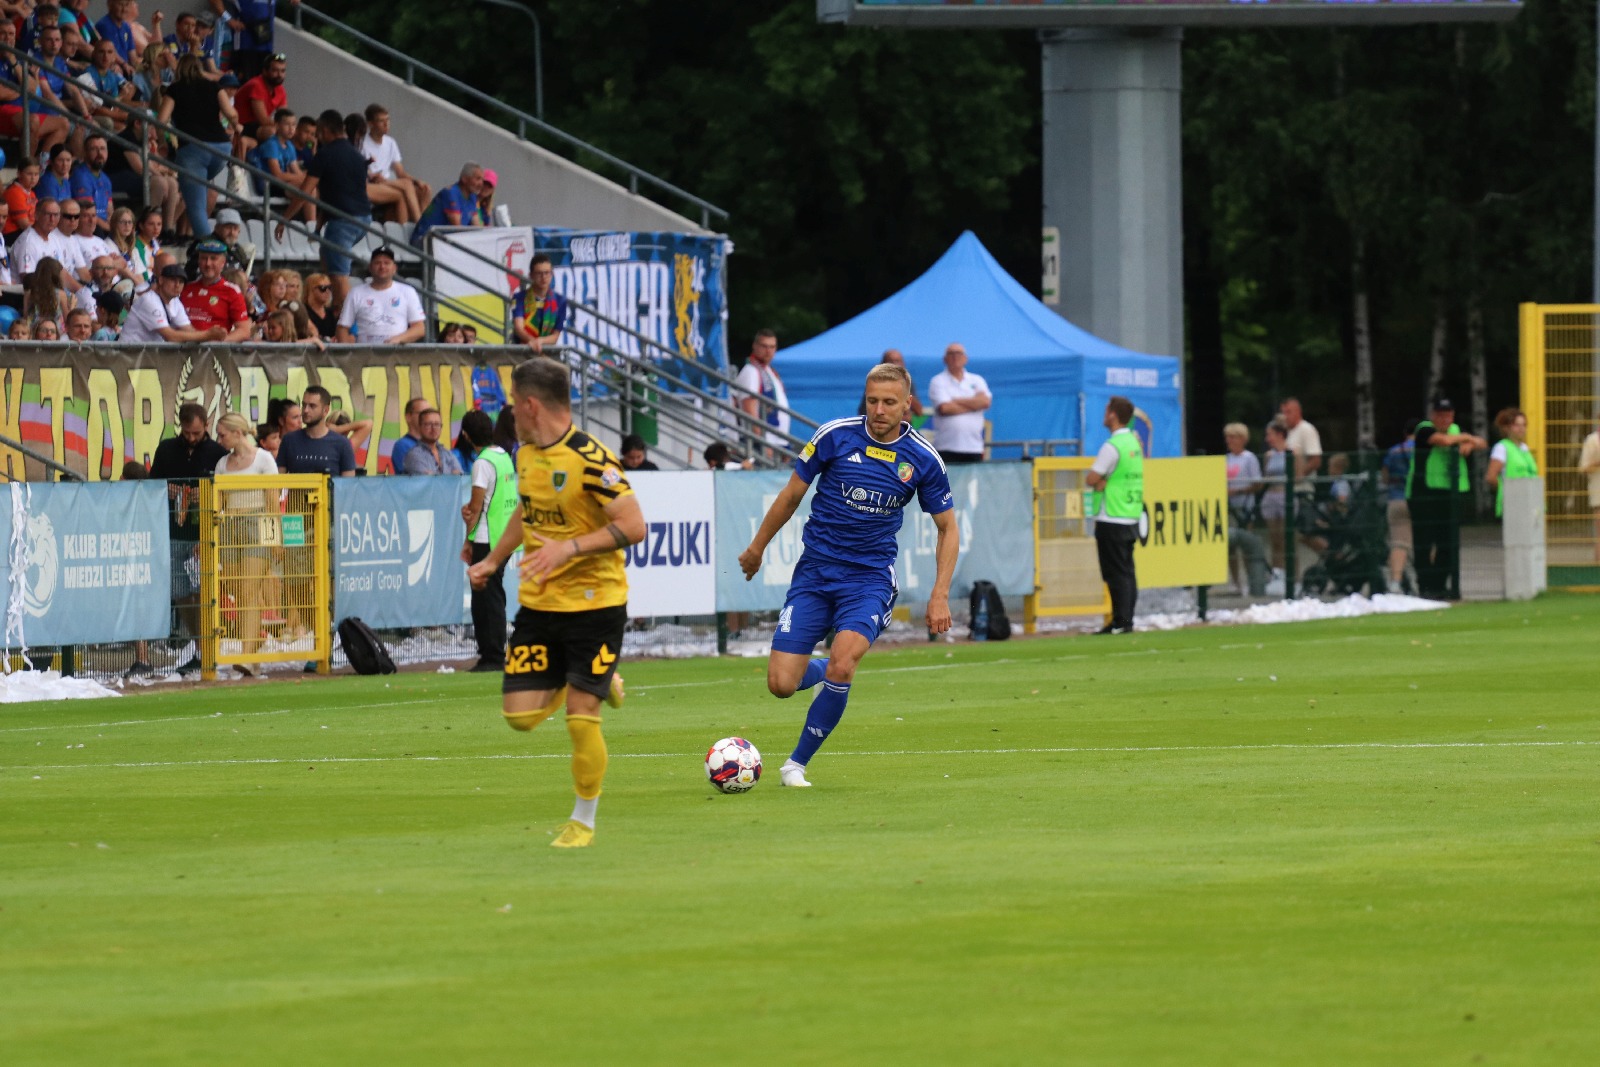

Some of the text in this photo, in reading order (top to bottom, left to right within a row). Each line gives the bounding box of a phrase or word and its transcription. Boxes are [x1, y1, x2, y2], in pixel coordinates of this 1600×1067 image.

[340, 510, 402, 554] DSA SA
[1138, 499, 1225, 548] ORTUNA
[64, 530, 152, 560] KLUB BIZNESU
[64, 562, 152, 589] MIEDZI LEGNICA
[340, 570, 403, 593] Financial Group
[775, 605, 794, 633] 4
